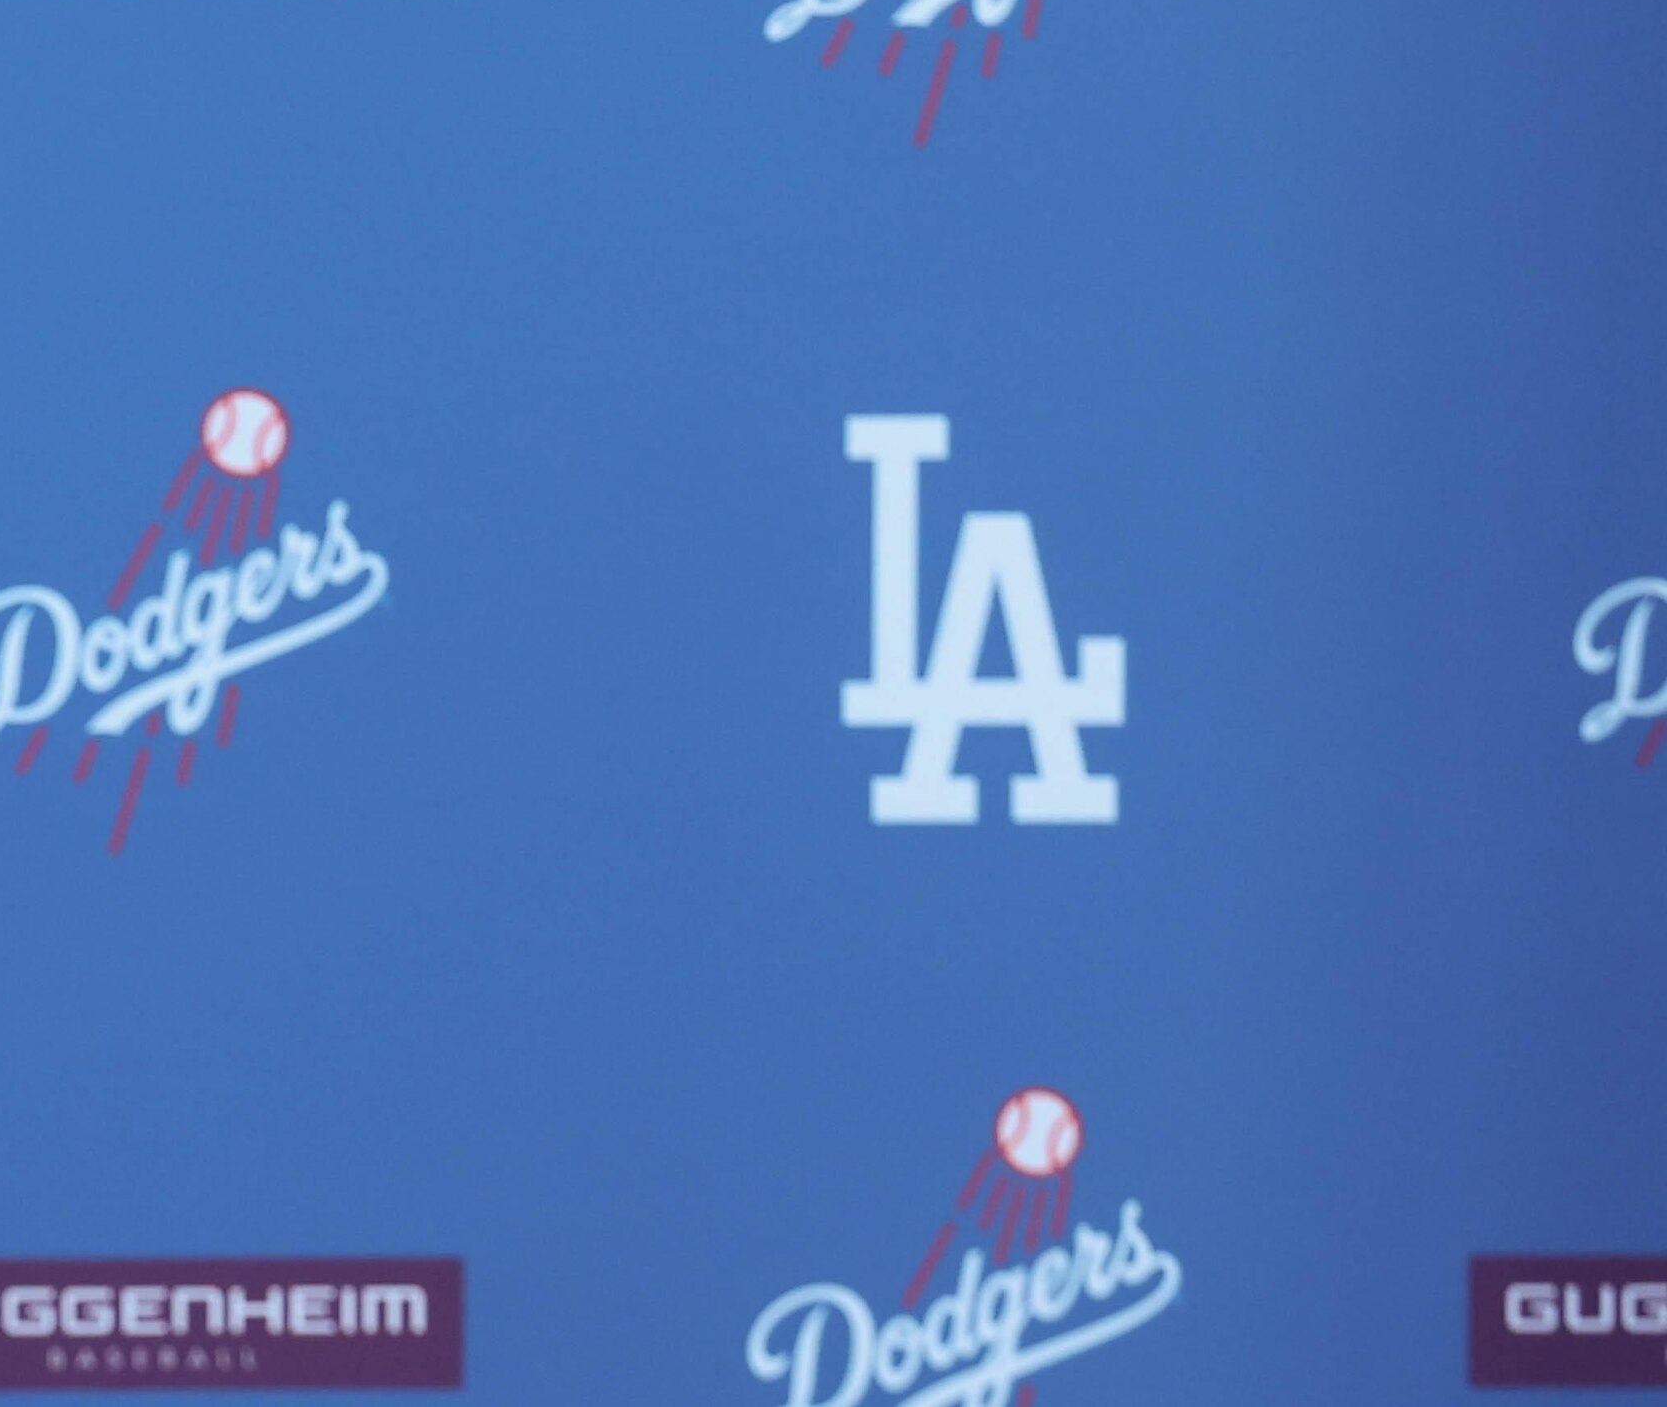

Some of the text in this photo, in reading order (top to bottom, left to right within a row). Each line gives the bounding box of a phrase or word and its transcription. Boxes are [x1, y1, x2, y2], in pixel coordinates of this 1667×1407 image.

[841, 414, 1127, 825] LA
[46, 1345, 259, 1374] BASEBALL
[748, 1201, 1181, 1407] Dodgers
